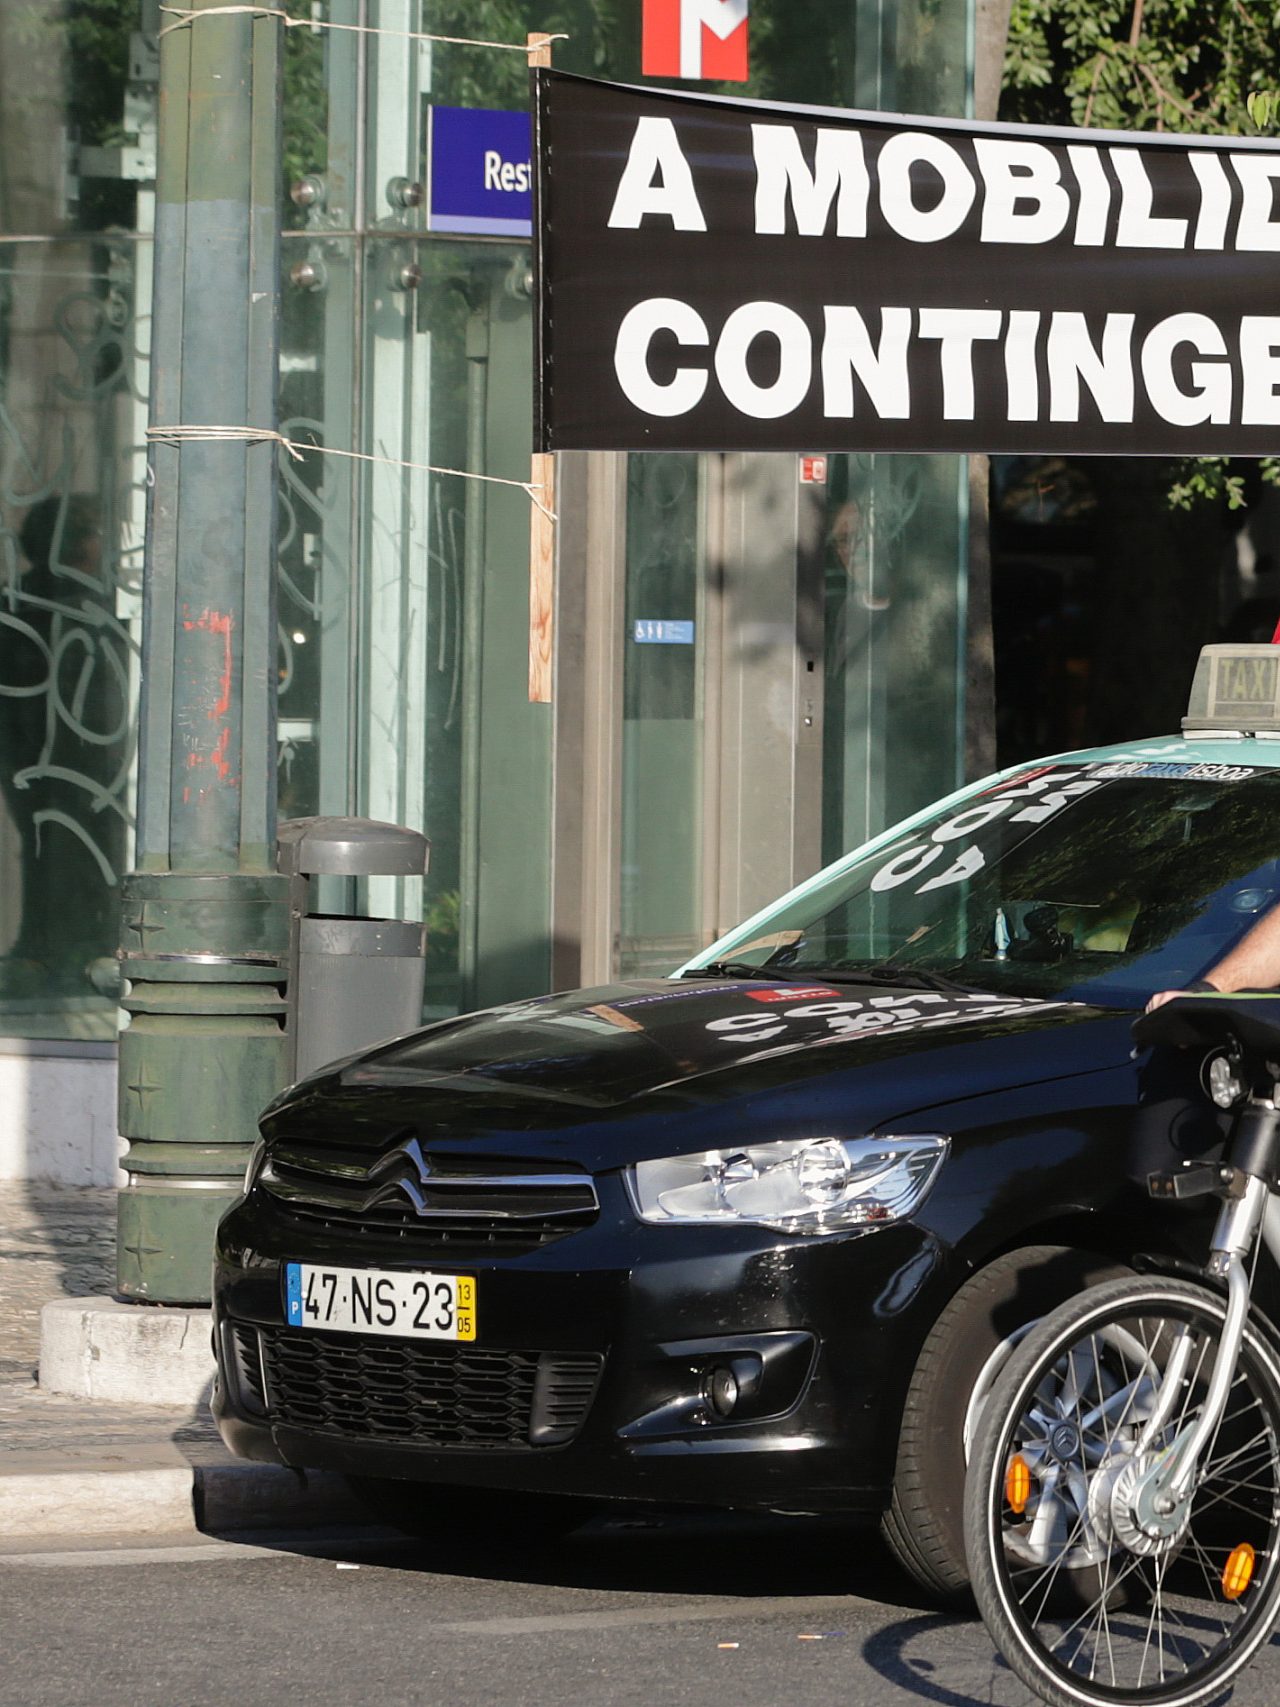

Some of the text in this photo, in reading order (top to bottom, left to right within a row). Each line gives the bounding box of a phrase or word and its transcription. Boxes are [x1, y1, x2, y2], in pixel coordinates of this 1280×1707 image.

[607, 116, 708, 232] A
[1220, 658, 1277, 700] TAXI
[458, 1284, 471, 1304] 13
[291, 1301, 299, 1315] P
[457, 1317, 471, 1333] 05
